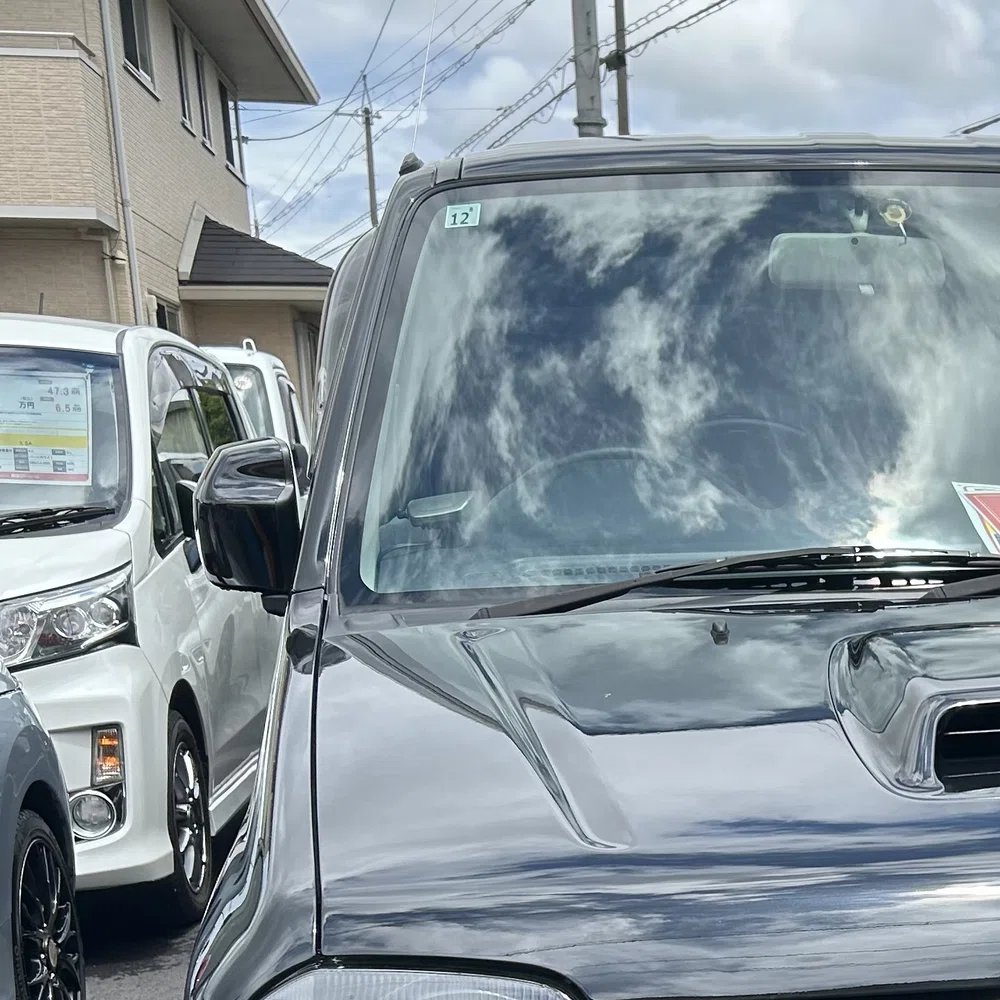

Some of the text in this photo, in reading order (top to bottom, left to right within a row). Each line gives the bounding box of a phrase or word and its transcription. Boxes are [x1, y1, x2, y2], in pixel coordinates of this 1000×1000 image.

[450, 212, 470, 226] 12
[18, 401, 35, 409] 万円
[55, 403, 71, 412] 6.5
